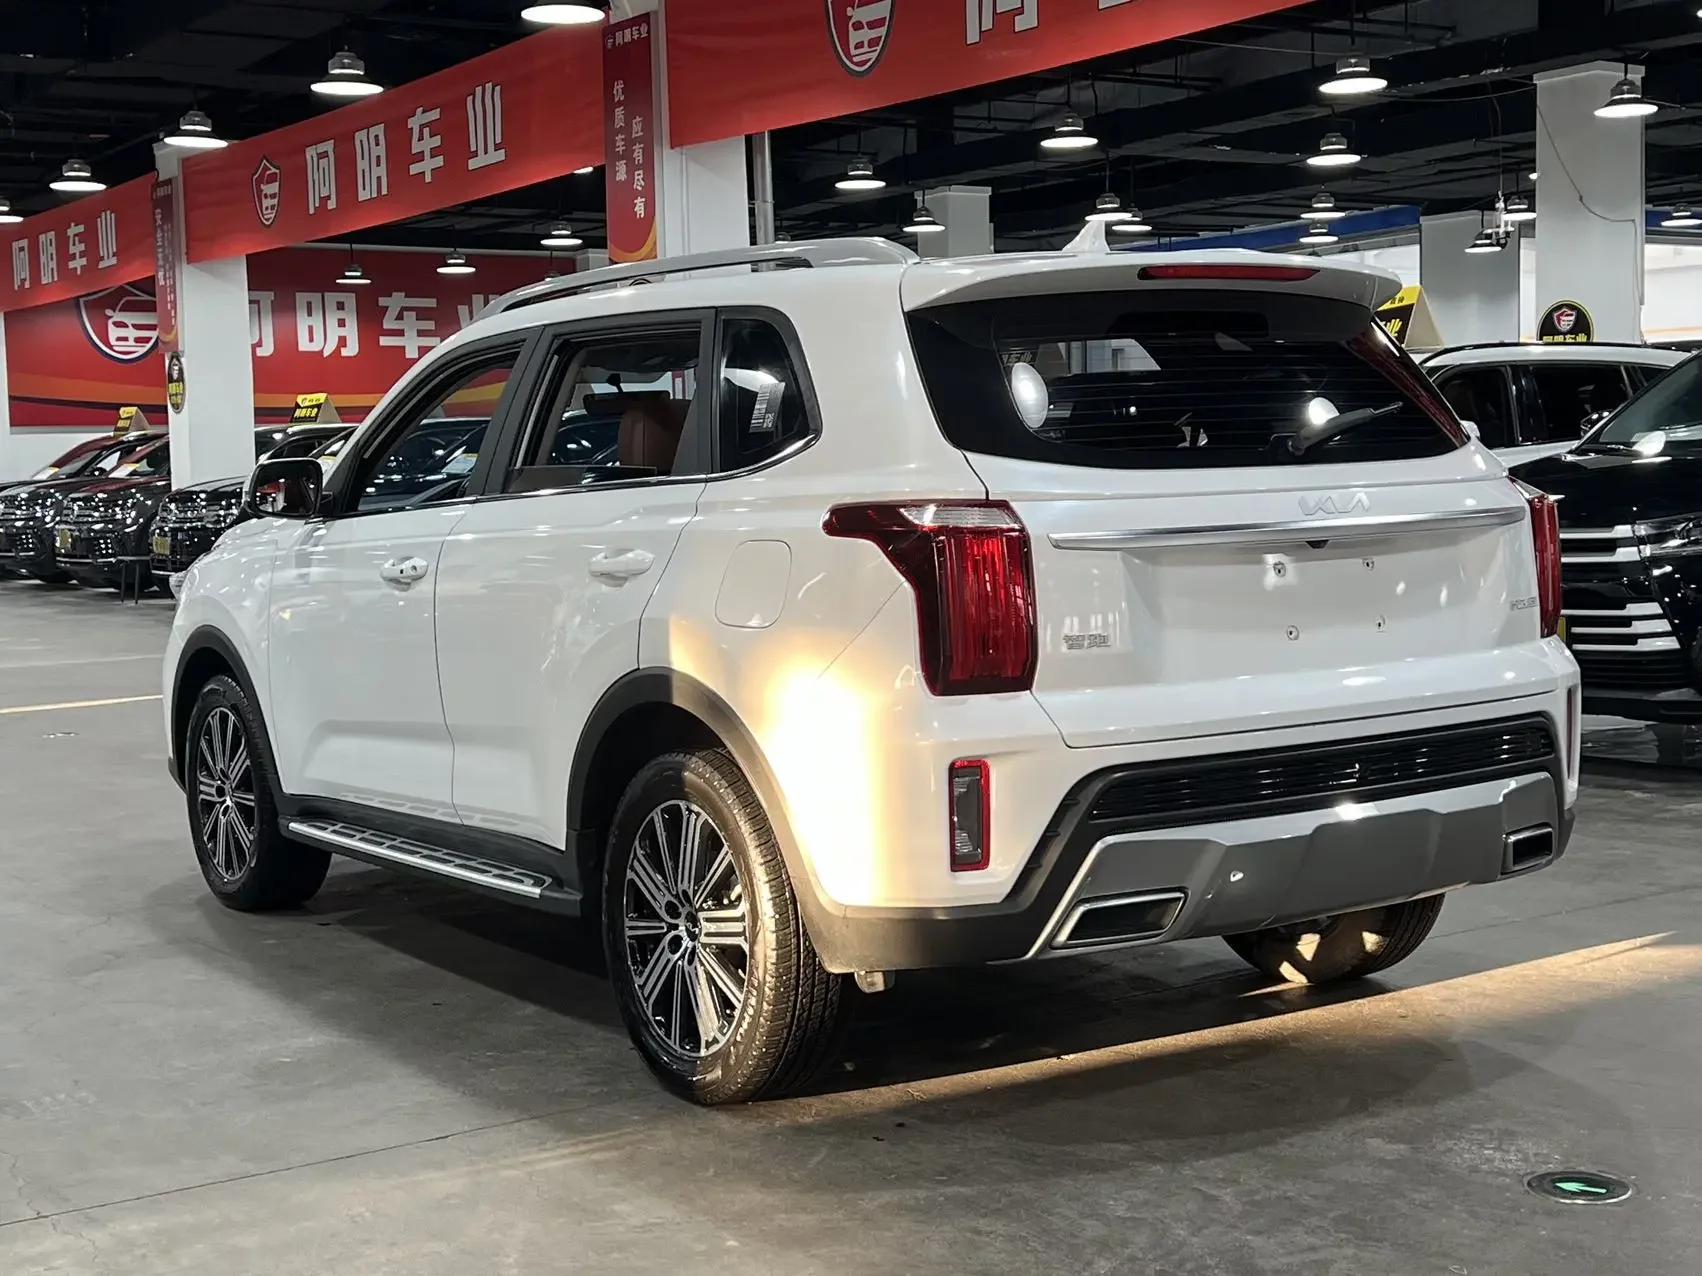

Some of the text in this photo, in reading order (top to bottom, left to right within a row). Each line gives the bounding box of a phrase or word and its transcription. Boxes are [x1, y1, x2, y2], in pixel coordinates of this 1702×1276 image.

[305, 82, 506, 215] 阿明车业
[613, 79, 627, 181] 优质车源
[631, 115, 646, 219] 应有尽有
[11, 210, 118, 291] 阿明车业
[249, 290, 500, 359] 明车
